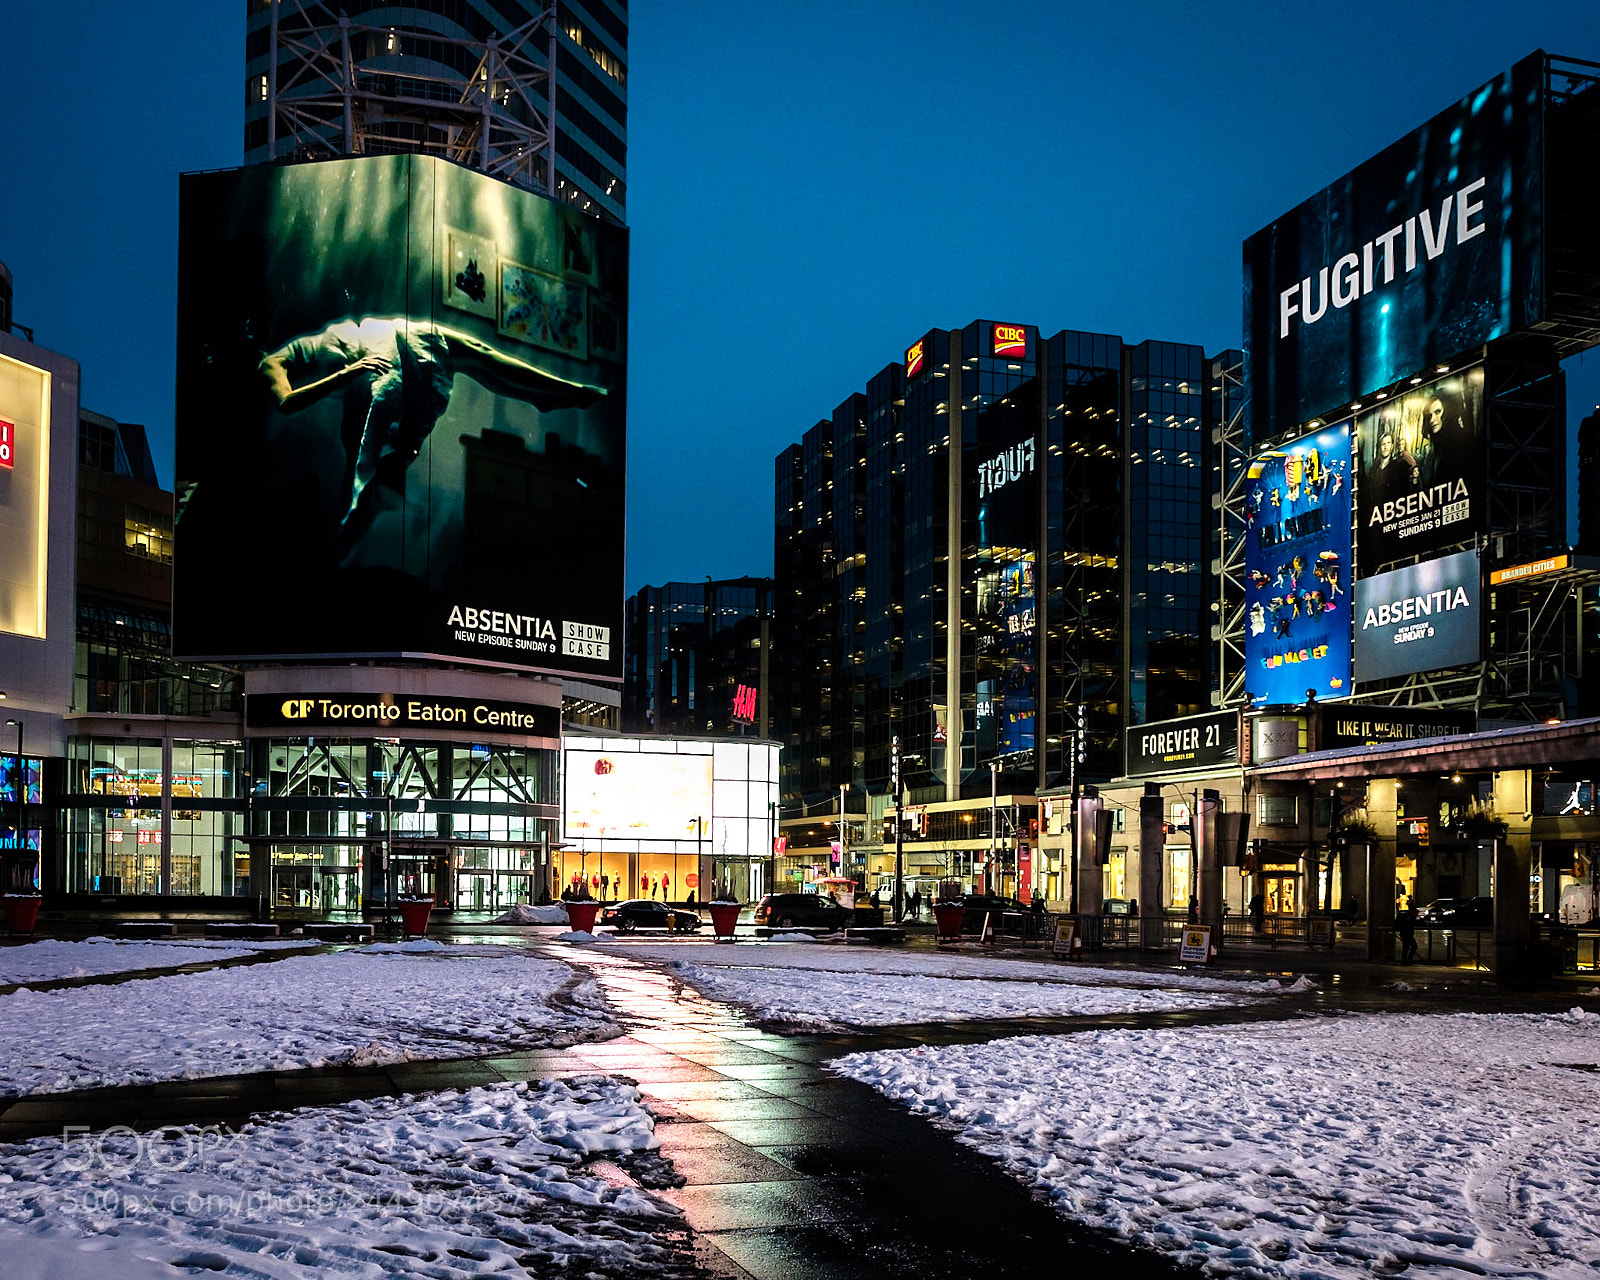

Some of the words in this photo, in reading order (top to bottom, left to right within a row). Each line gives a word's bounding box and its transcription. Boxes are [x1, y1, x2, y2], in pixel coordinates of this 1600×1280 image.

[1280, 176, 1486, 339] FUGITIVE
[995, 326, 1025, 342] CIBC
[907, 341, 923, 362] CIBC
[1368, 477, 1469, 528] ABSENTIA
[1445, 500, 1467, 514] SHOW
[1383, 524, 1397, 534] NEW
[1398, 515, 1420, 529] SERIES
[1420, 512, 1433, 523] JAN
[1445, 511, 1466, 523] CASE
[1398, 520, 1434, 539] SUNDAYS
[1434, 518, 1441, 528] 9
[1501, 565, 1532, 581] BRANDED
[1532, 560, 1556, 573] CITIES
[1362, 586, 1470, 630] ABSENTIA
[447, 605, 557, 641] ABSENTIA
[569, 624, 604, 641] SHOW
[454, 630, 476, 643] NEW
[477, 633, 514, 648] EPISODE
[515, 638, 548, 653] SUNDAY
[549, 643, 556, 654] 9
[1393, 628, 1426, 645] SUNDAY
[1427, 626, 1435, 638] 9
[568, 641, 603, 657] CASE
[1260, 654, 1283, 669] FUN
[1284, 645, 1329, 664] MAGNET
[281, 700, 315, 719] CF
[318, 700, 401, 721] Toronto
[407, 701, 468, 723] Eaton
[473, 705, 535, 729] Centre
[1337, 719, 1360, 736] LIKE
[1374, 722, 1403, 739] WEAR
[1418, 724, 1449, 739] SHARE
[1142, 727, 1200, 757] FOREVER
[1205, 724, 1220, 748] 21
